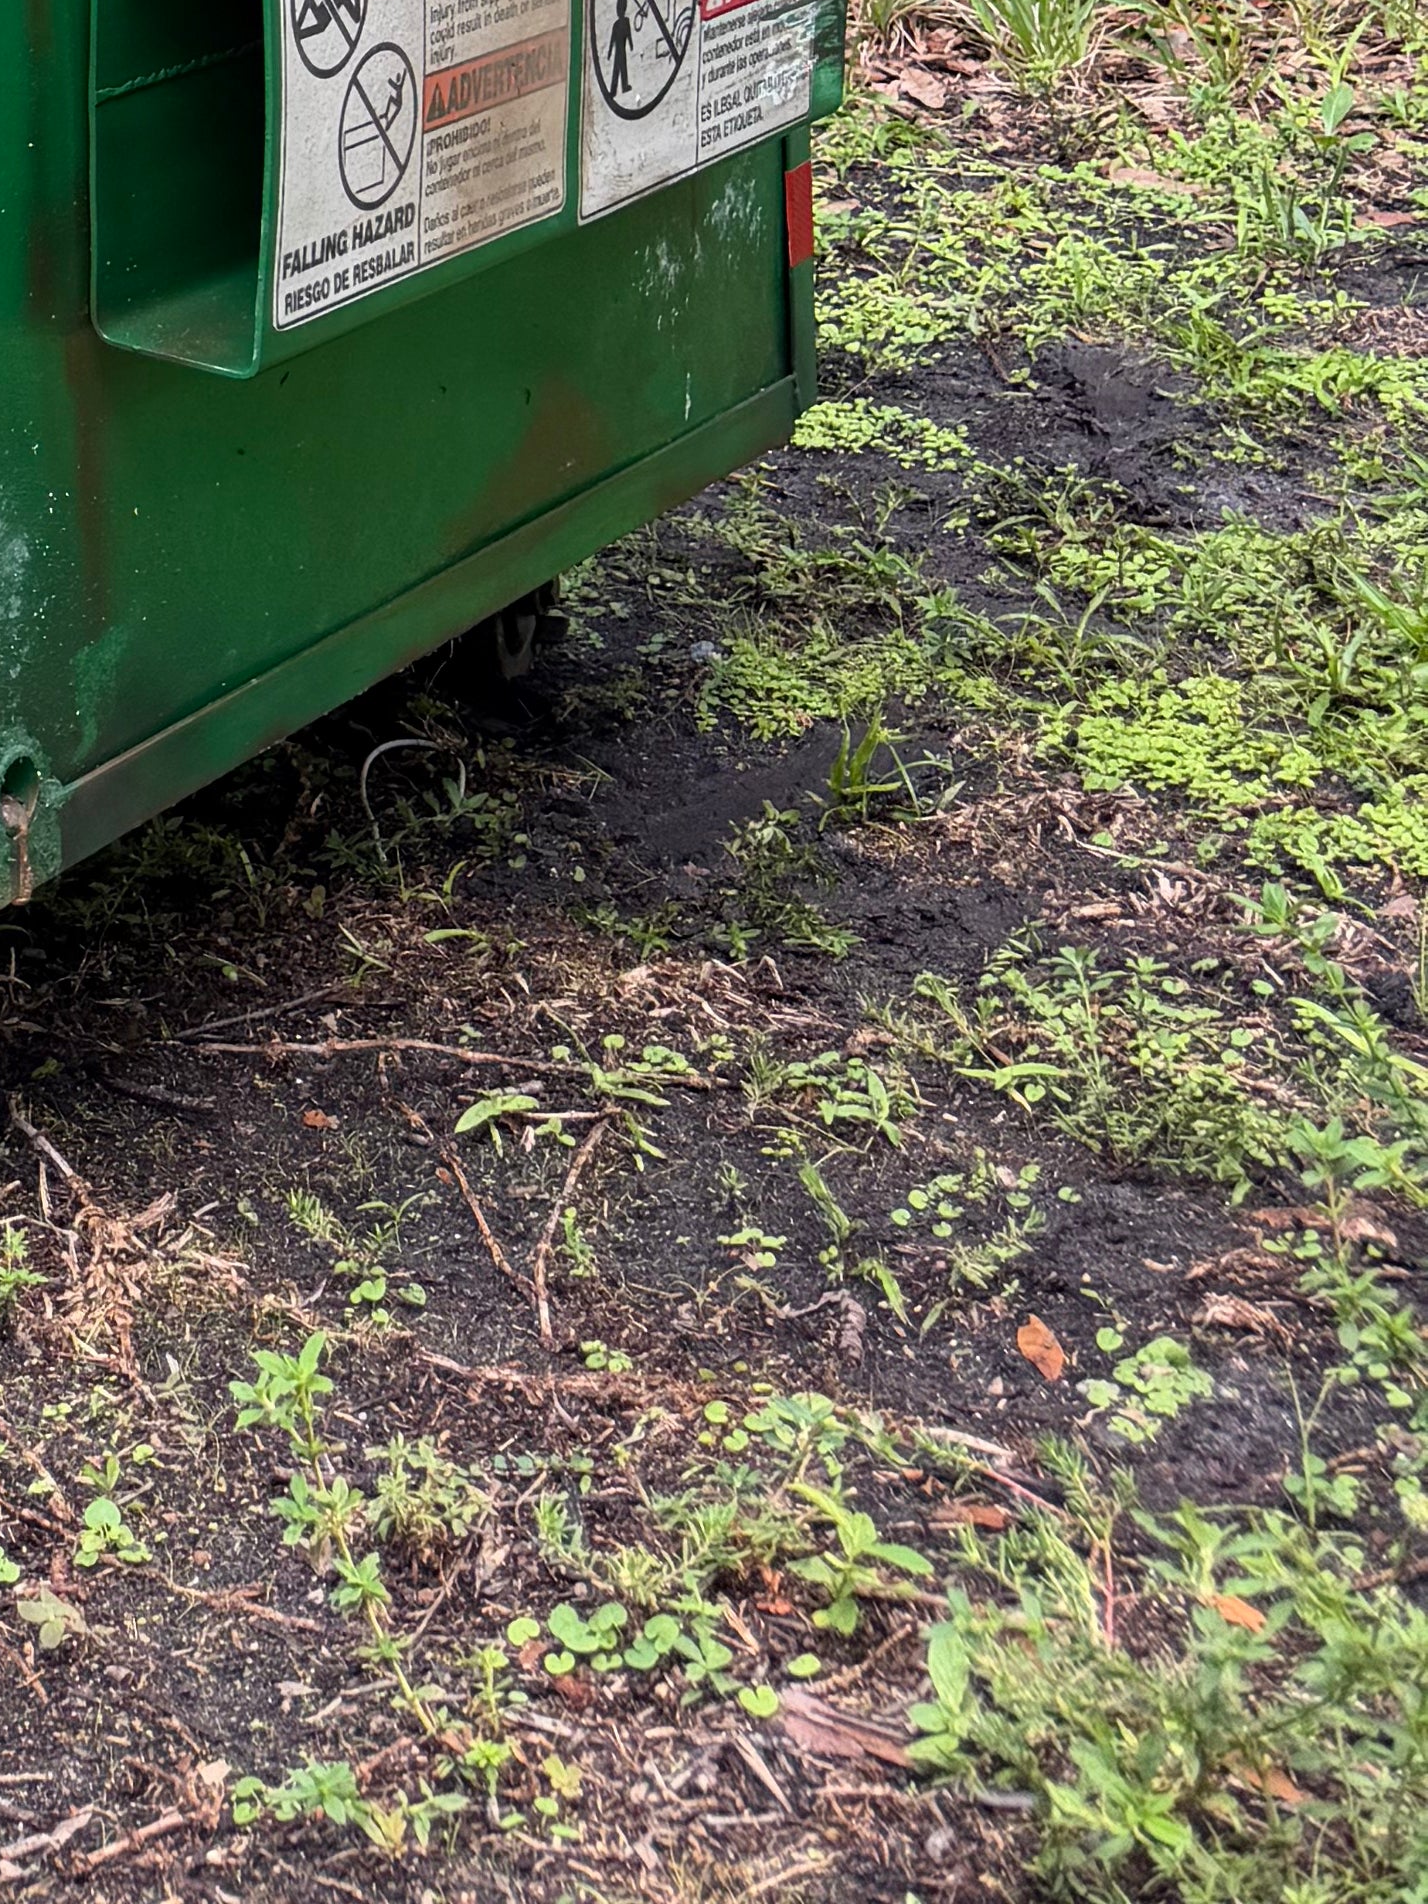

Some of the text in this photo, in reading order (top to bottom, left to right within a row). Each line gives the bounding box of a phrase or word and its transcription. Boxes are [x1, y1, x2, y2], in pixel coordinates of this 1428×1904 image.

[430, 4, 455, 26] Injury
[430, 24, 455, 46] could
[456, 13, 482, 37] result
[483, 10, 492, 27] in
[494, 3, 518, 24] death
[520, 0, 530, 15] or
[702, 34, 744, 65] contenedor
[445, 40, 563, 113] ADVERTENCIA
[707, 59, 736, 85] durante
[736, 52, 748, 71] las
[701, 103, 712, 123] ES
[714, 89, 743, 116] ILEGAL
[701, 126, 722, 148] ESTA
[426, 159, 438, 177] No
[282, 202, 416, 281] FALLING HAZARD
[284, 241, 415, 316] RIESGO DE RESBALAR
